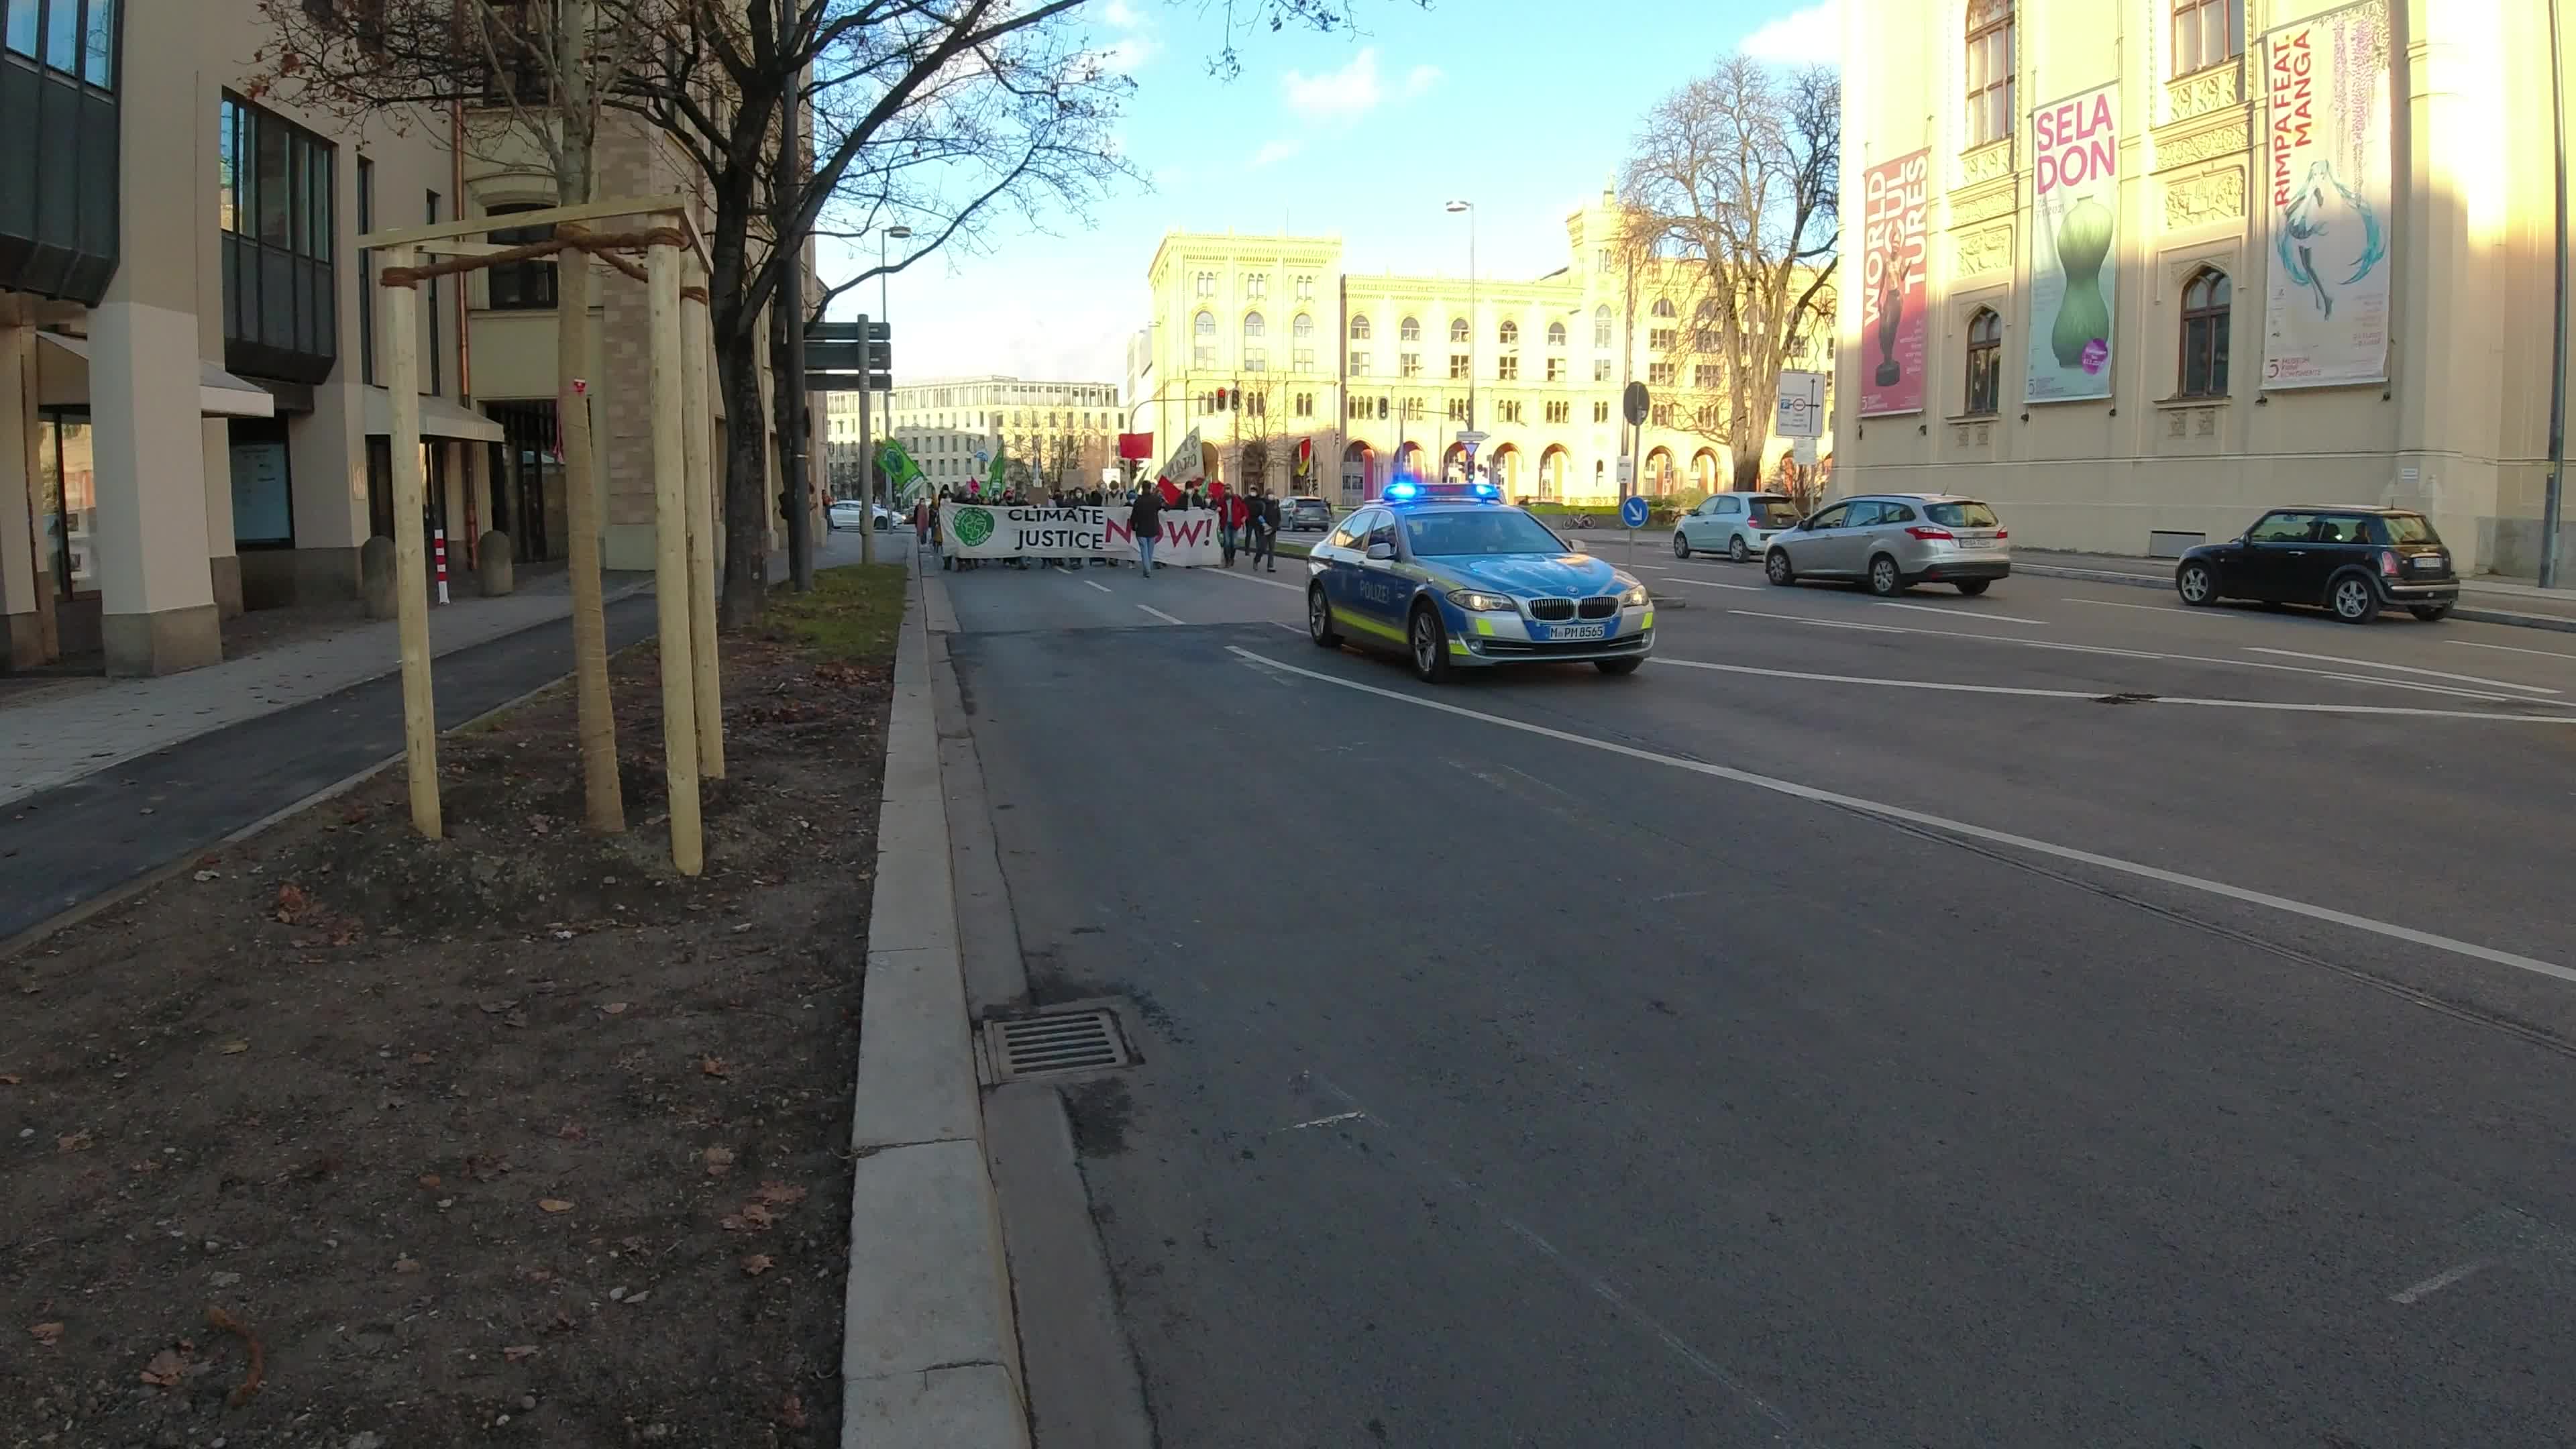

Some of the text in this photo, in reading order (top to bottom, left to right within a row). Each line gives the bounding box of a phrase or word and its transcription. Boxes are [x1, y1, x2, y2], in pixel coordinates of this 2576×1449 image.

[2036, 93, 2114, 152] SELA
[2273, 34, 2292, 207] RIMPA FEAT.
[2293, 28, 2312, 147] MANGA
[2037, 135, 2115, 195] DON
[1864, 170, 1886, 327] WORLD
[1904, 155, 1927, 294] TURES
[1008, 507, 1104, 525] CLIMATE
[1014, 529, 1104, 551] JUSTICE
